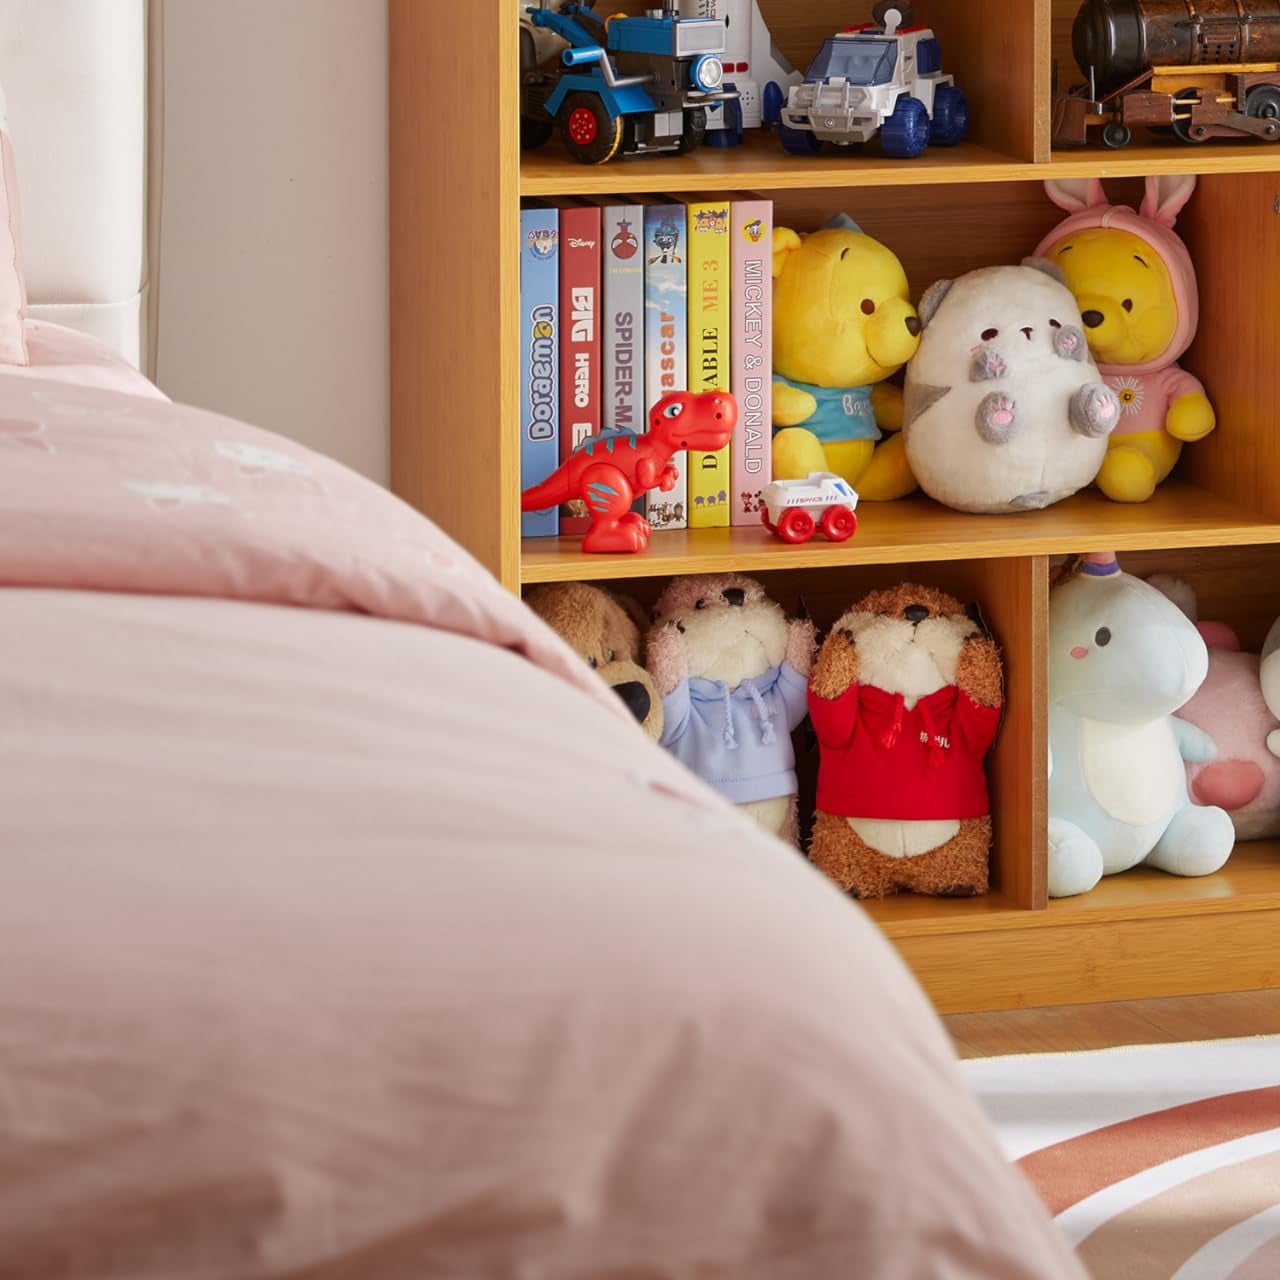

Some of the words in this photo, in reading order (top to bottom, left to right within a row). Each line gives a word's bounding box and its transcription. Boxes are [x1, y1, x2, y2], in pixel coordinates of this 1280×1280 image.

[567, 238, 596, 249] Disney
[704, 259, 719, 272] 3
[571, 287, 594, 342] BIG
[703, 280, 719, 312] ME
[744, 260, 763, 348] MICKEY
[527, 304, 555, 442] Doraemon
[574, 353, 590, 408] HERO
[744, 354, 763, 370] &
[744, 377, 763, 474] DONALD
